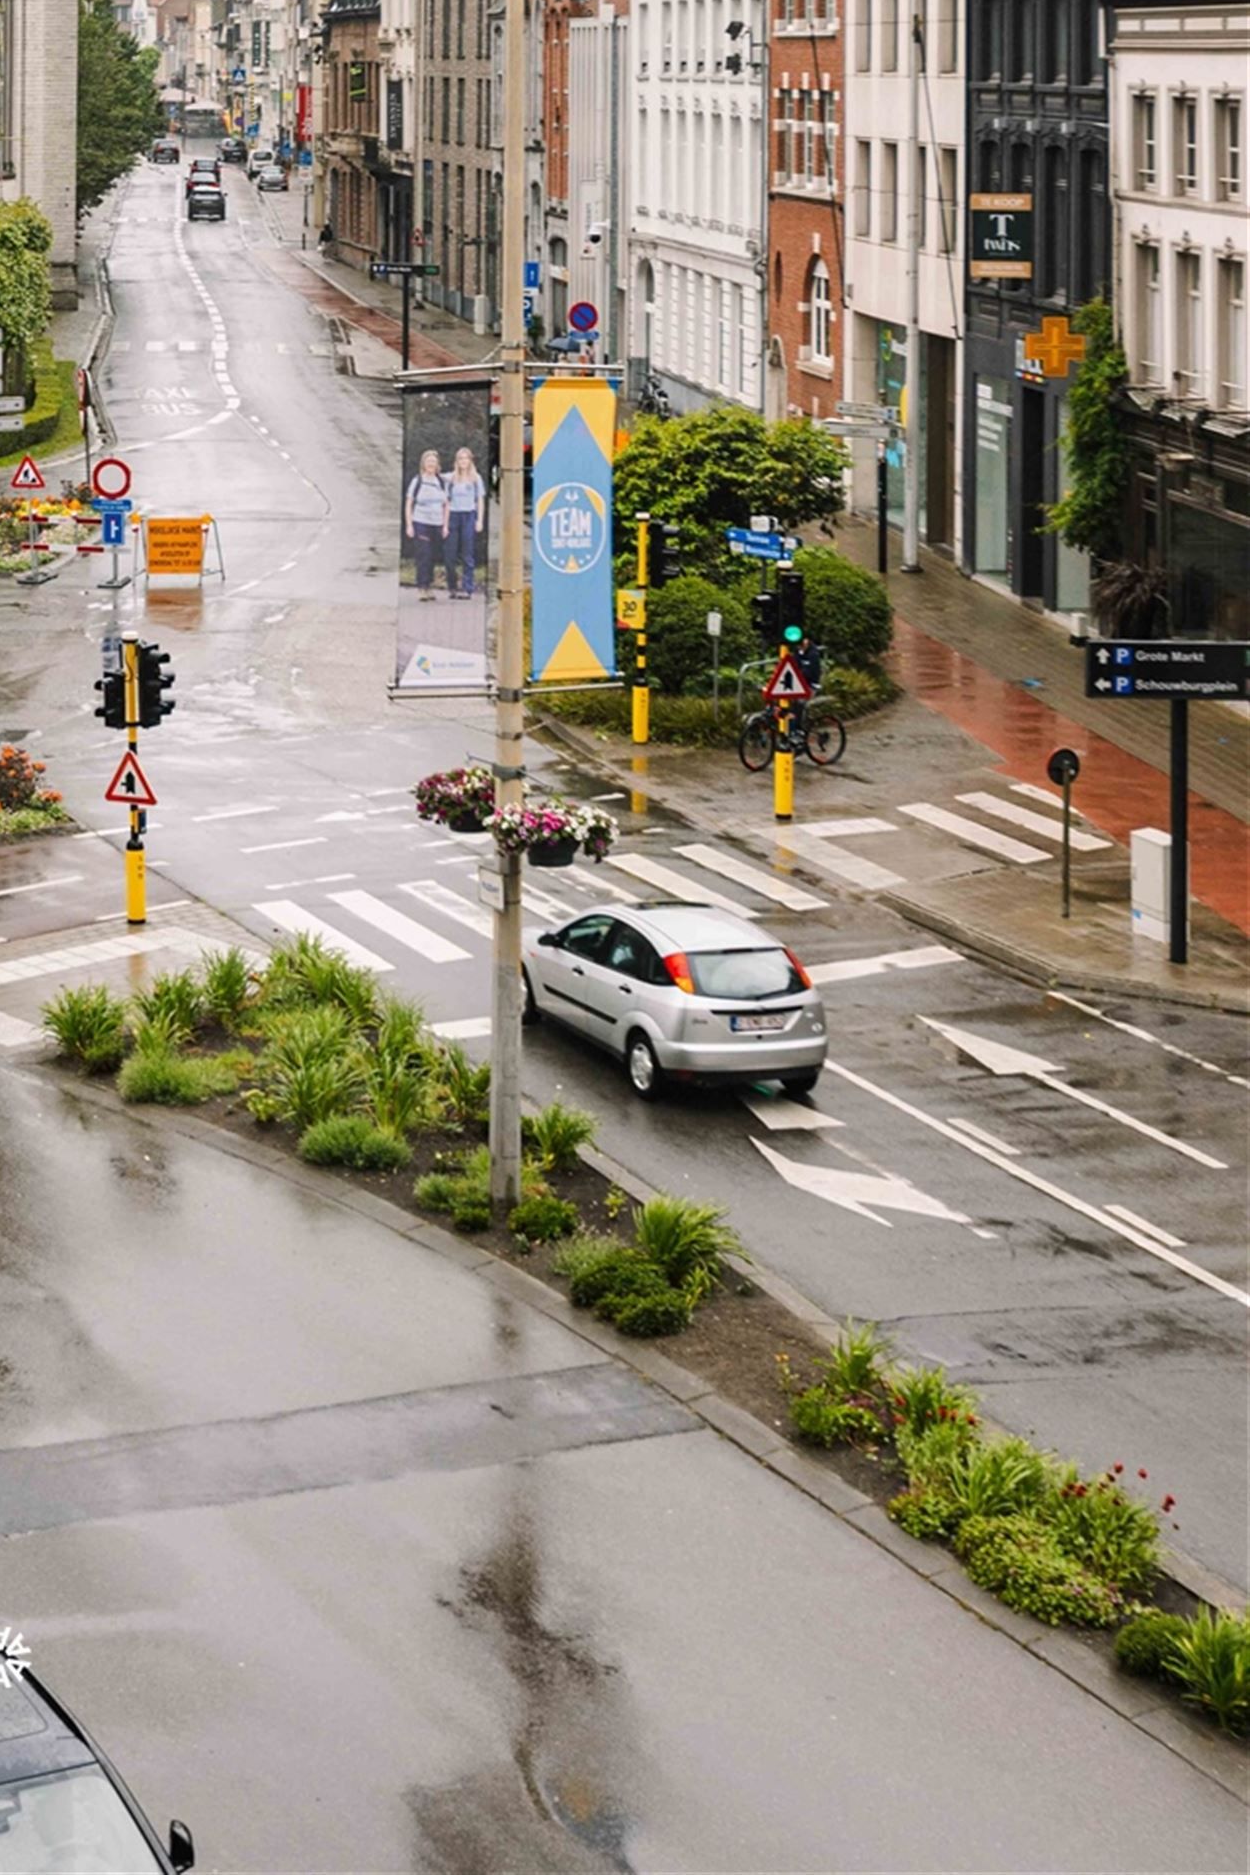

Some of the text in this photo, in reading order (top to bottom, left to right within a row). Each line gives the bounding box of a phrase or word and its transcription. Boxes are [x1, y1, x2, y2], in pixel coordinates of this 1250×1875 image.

[548, 507, 592, 537] TEAM
[623, 600, 637, 612] 30
[1135, 650, 1168, 662] Grote
[1171, 650, 1205, 663] Markt
[1135, 678, 1238, 694] Schouwburgplein
